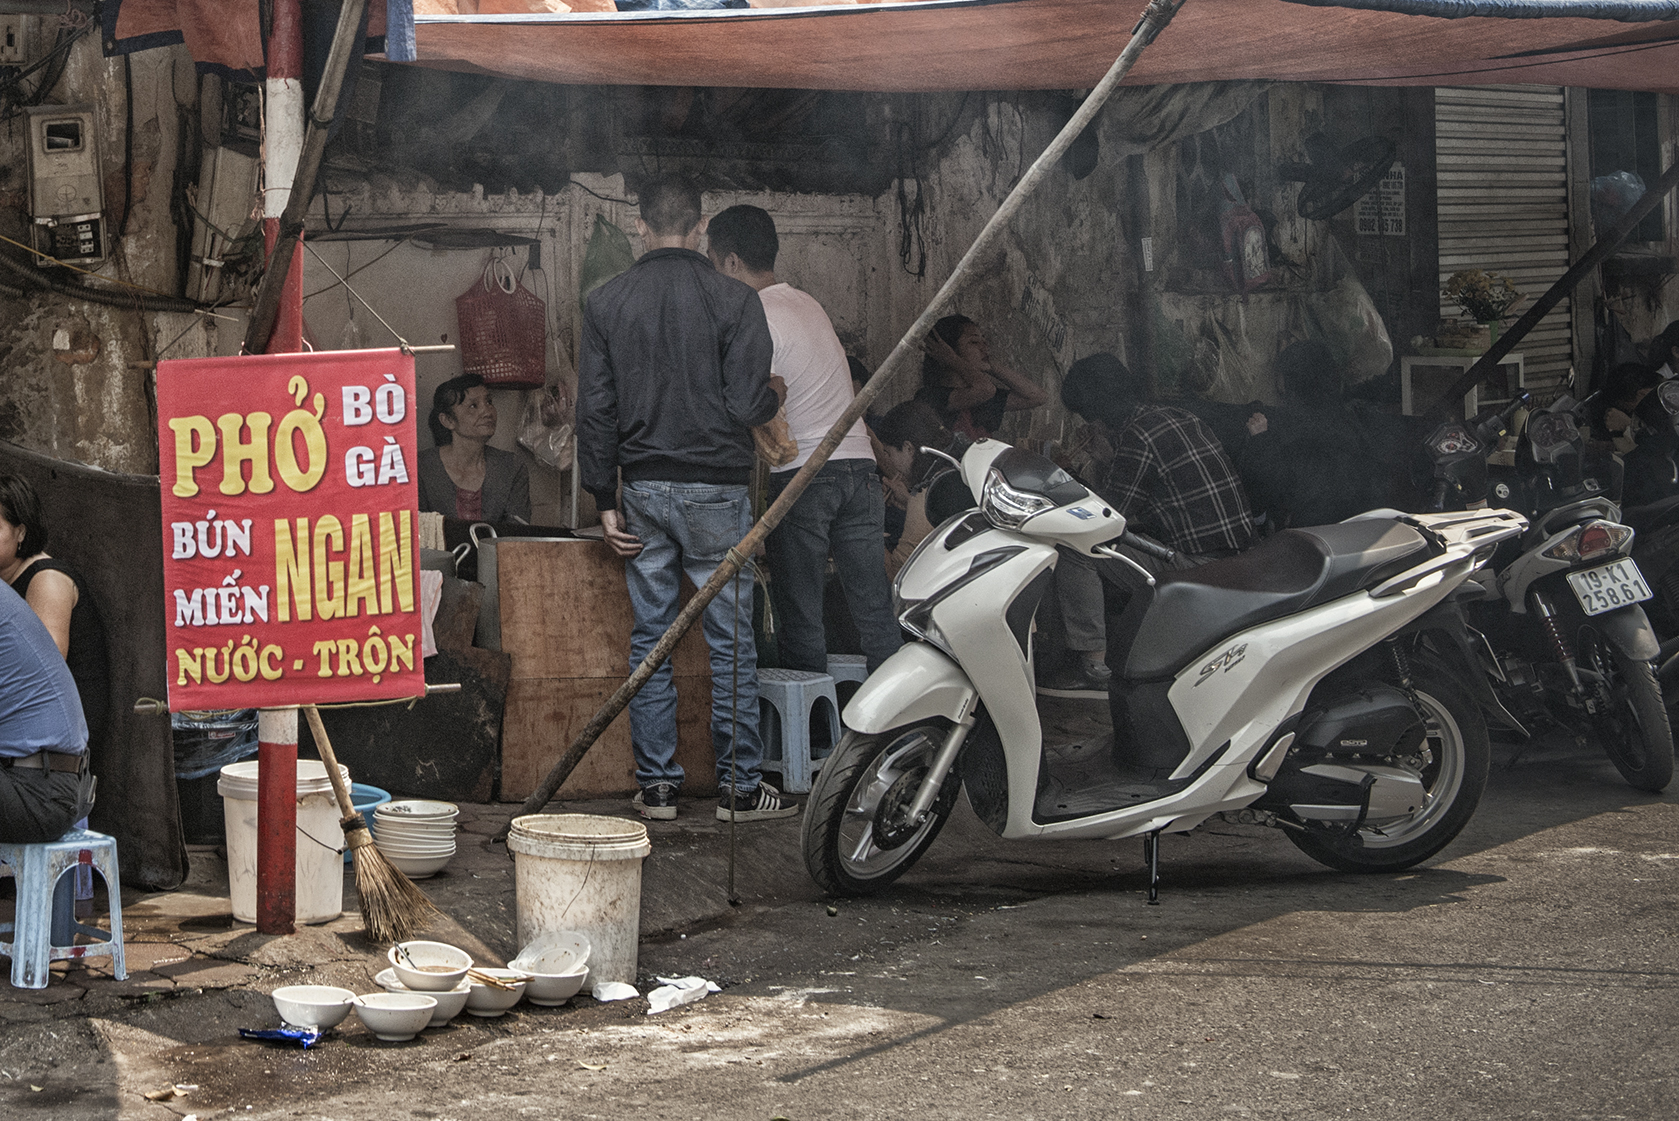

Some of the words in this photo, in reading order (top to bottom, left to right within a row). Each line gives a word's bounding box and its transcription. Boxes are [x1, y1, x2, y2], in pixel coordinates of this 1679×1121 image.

[341, 373, 406, 426] BÒ
[168, 375, 328, 498] PHỞ
[344, 436, 409, 488] GÀ
[171, 509, 253, 560] BÚN
[274, 509, 415, 622] NGAN
[1580, 563, 1630, 591] 19-K1
[173, 568, 270, 627] MIẾN
[1582, 580, 1647, 613] 258.61
[175, 635, 283, 686] NƯỚC
[312, 625, 415, 684] TRỘN
